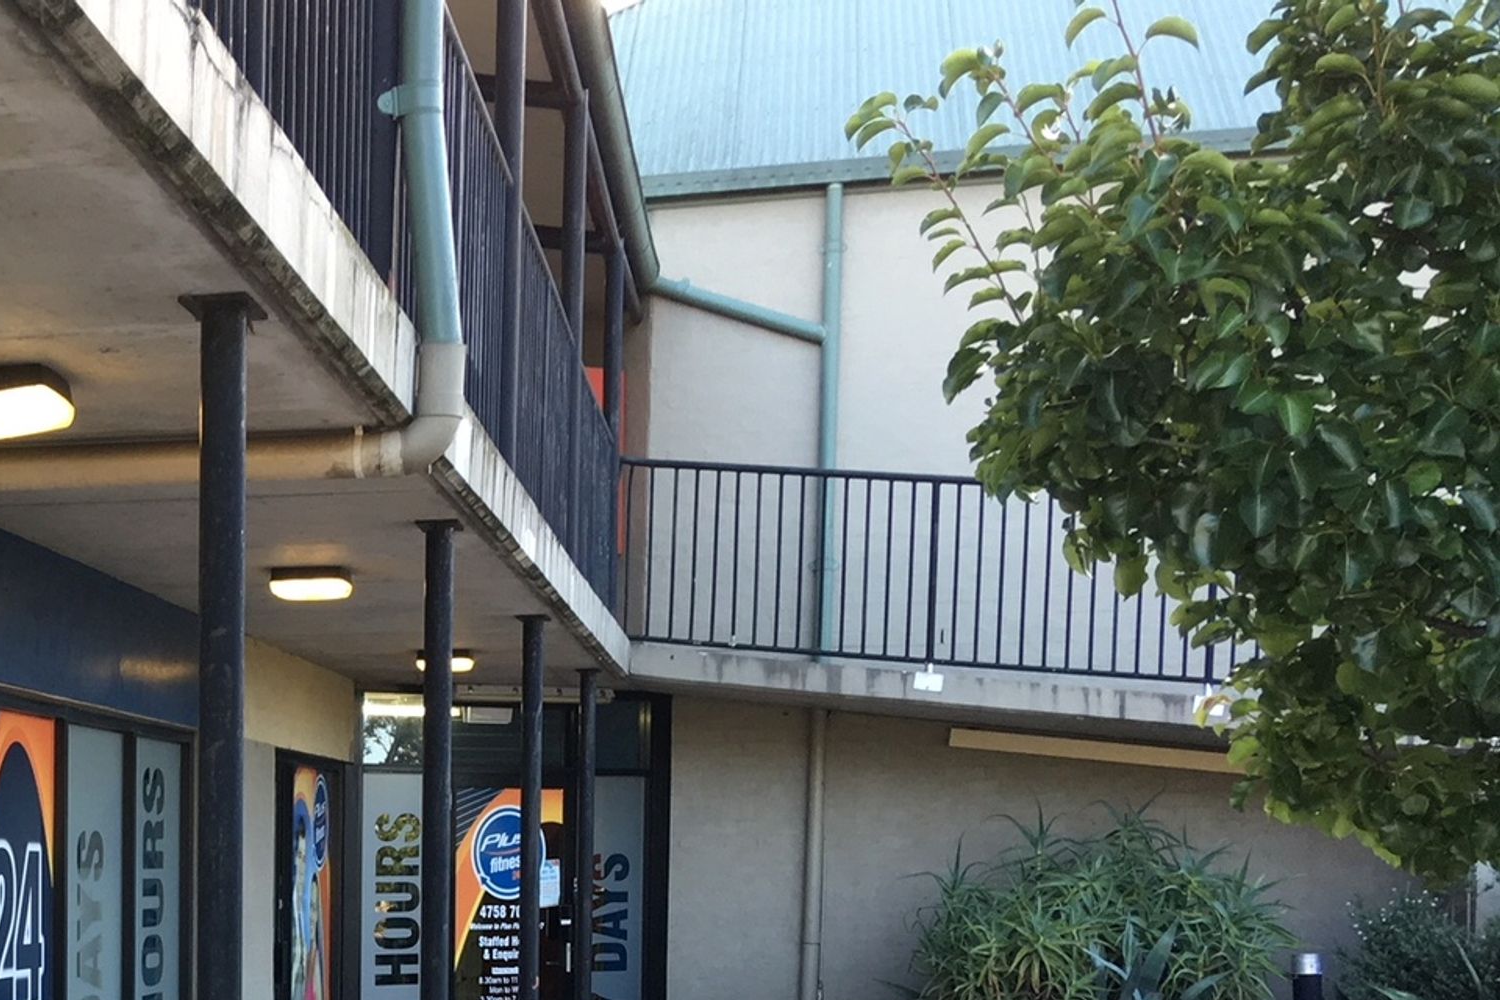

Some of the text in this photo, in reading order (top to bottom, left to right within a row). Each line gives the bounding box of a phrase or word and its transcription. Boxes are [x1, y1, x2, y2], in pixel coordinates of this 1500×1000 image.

[491, 855, 521, 873] fitnes
[374, 812, 421, 987] HOURS
[479, 904, 507, 918] 4758
[591, 853, 630, 972] DAYS
[478, 935, 509, 947] Staffed
[483, 948, 520, 962] & Enquir
